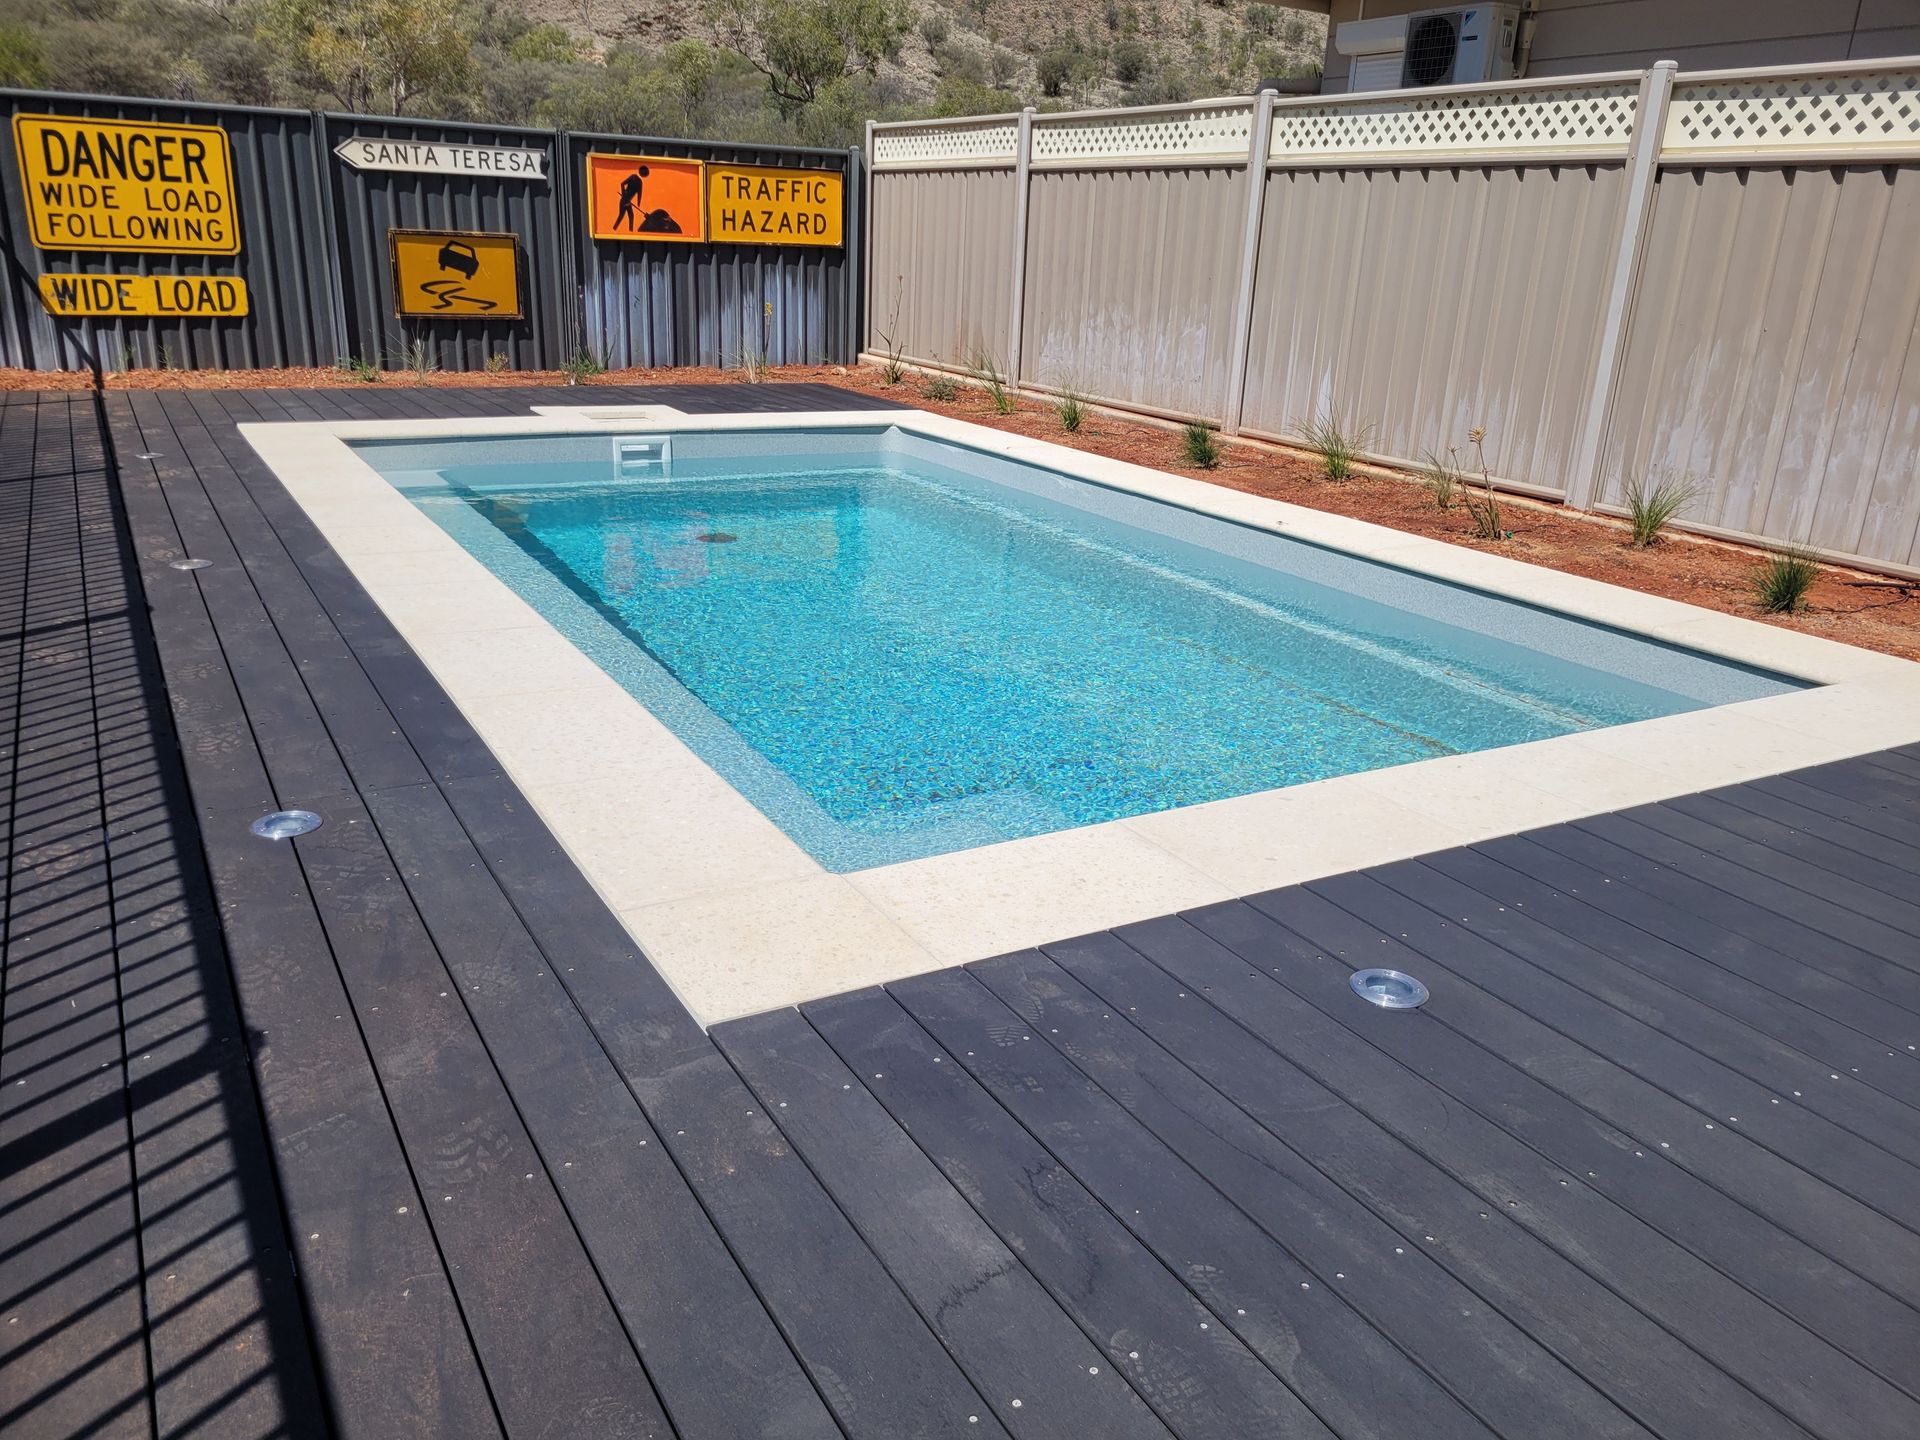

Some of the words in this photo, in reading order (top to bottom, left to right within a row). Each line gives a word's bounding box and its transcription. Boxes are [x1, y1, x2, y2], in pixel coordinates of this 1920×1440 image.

[40, 128, 209, 184] DANGER
[362, 143, 439, 166] SANTA
[450, 149, 536, 172] TERESA
[40, 183, 119, 208] WIDE
[144, 187, 222, 213] LOAD
[721, 175, 827, 204] TRAFFIC
[47, 213, 223, 242] FOLLOWING
[722, 209, 827, 235] HAZARD
[51, 278, 137, 311] WIDE
[154, 279, 236, 312] LOAD
